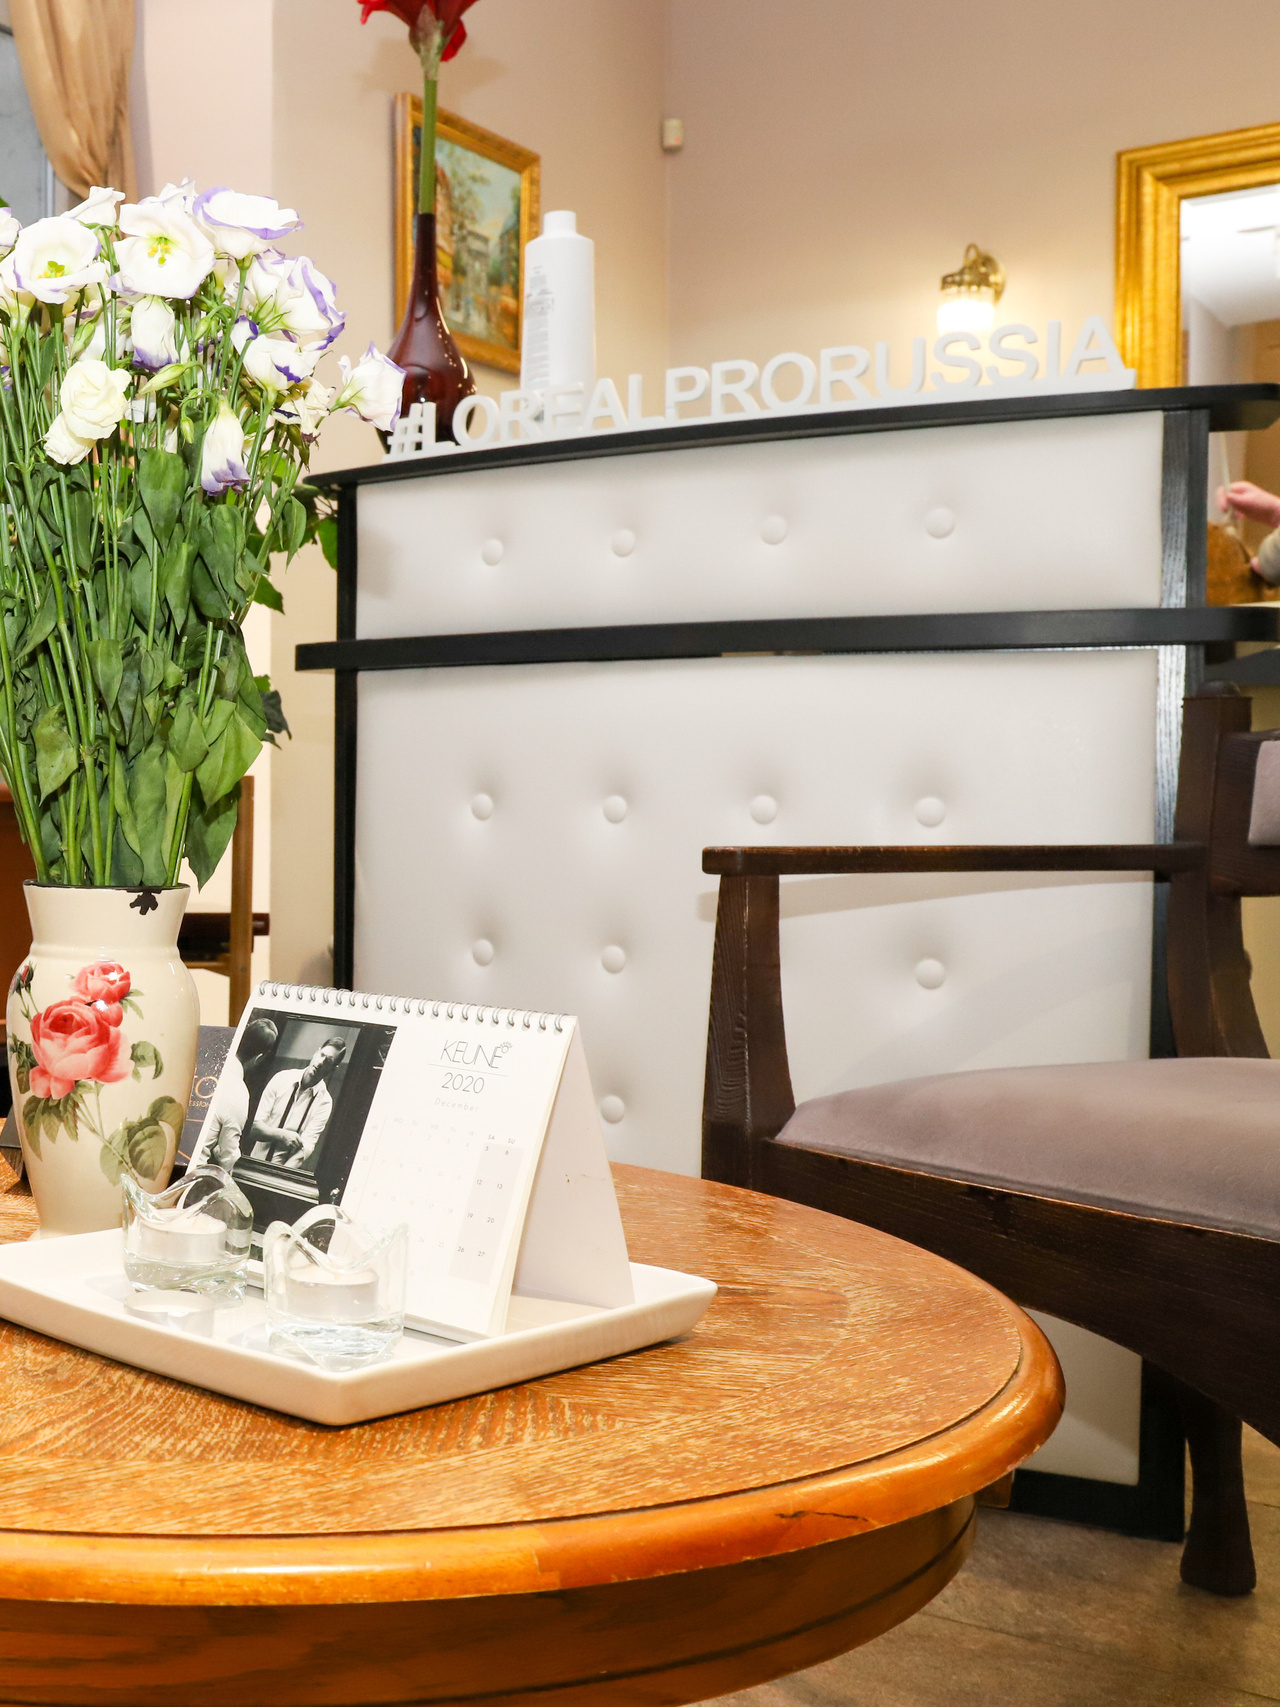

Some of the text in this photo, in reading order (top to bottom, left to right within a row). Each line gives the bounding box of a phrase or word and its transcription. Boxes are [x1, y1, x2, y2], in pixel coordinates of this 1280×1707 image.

[440, 1040, 503, 1069] KEUNE
[441, 1072, 485, 1094] 2020
[435, 1098, 479, 1112] December
